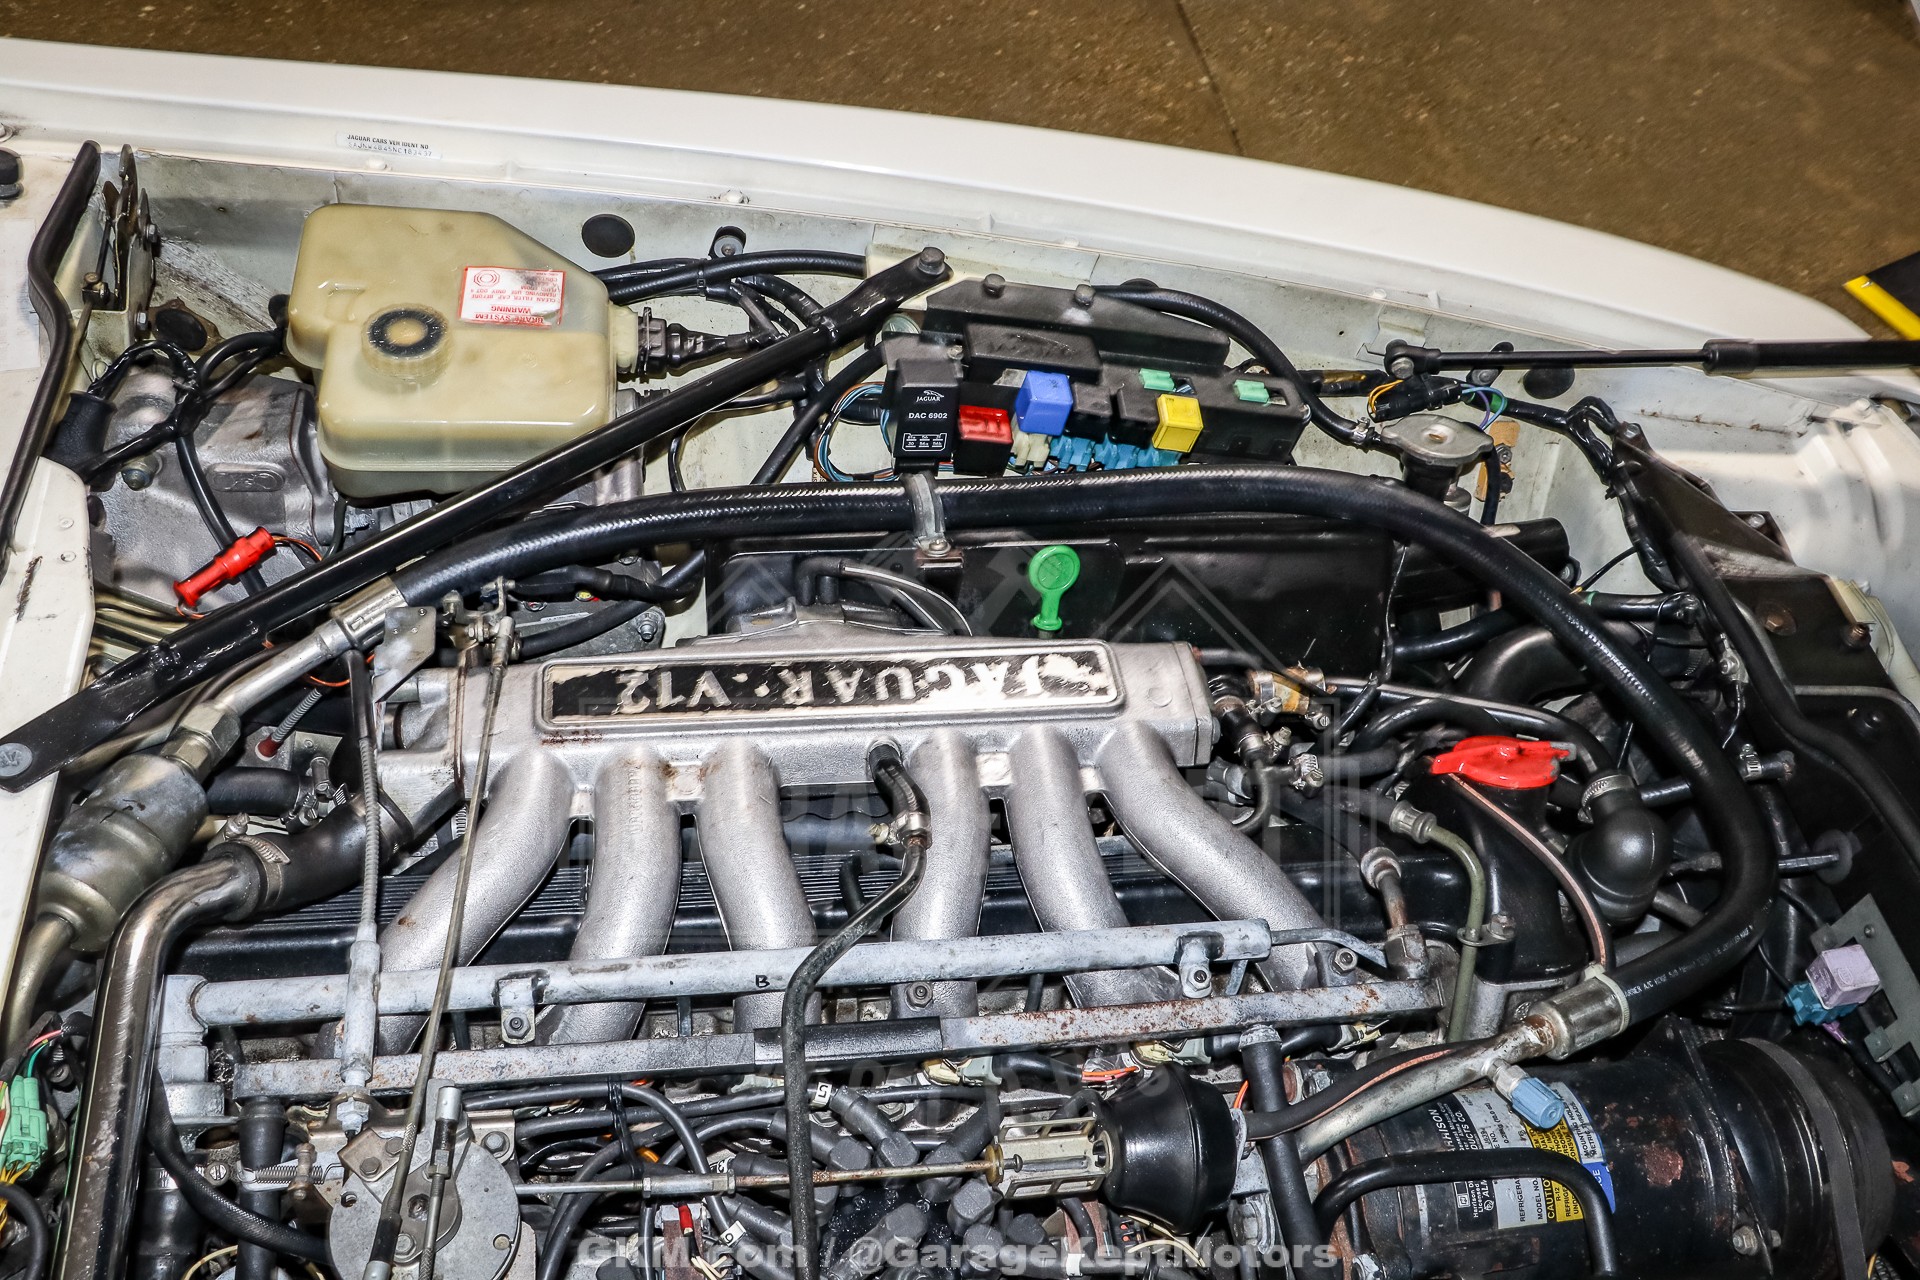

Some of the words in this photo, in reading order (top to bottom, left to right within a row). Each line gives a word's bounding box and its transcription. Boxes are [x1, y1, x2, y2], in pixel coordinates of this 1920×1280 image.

[347, 134, 371, 142] JAGUAR
[401, 141, 418, 149] IDENT
[475, 313, 511, 321] SYSTEM
[491, 306, 531, 314] WARNING
[612, 670, 733, 715] V12
[781, 654, 1045, 707] JAGUAR
[755, 974, 769, 988] B
[1564, 1132, 1576, 1160] ONSULT
[1572, 1121, 1589, 1157] MOUNTING
[1584, 1130, 1598, 1156] METRIC
[1470, 1187, 1479, 1218] Harrison
[1475, 1183, 1484, 1213] Licensed
[1514, 1178, 1526, 1222] REFRIGERA
[1532, 1193, 1543, 1220] MODEL
[1542, 1179, 1556, 1219] CAUTIO
